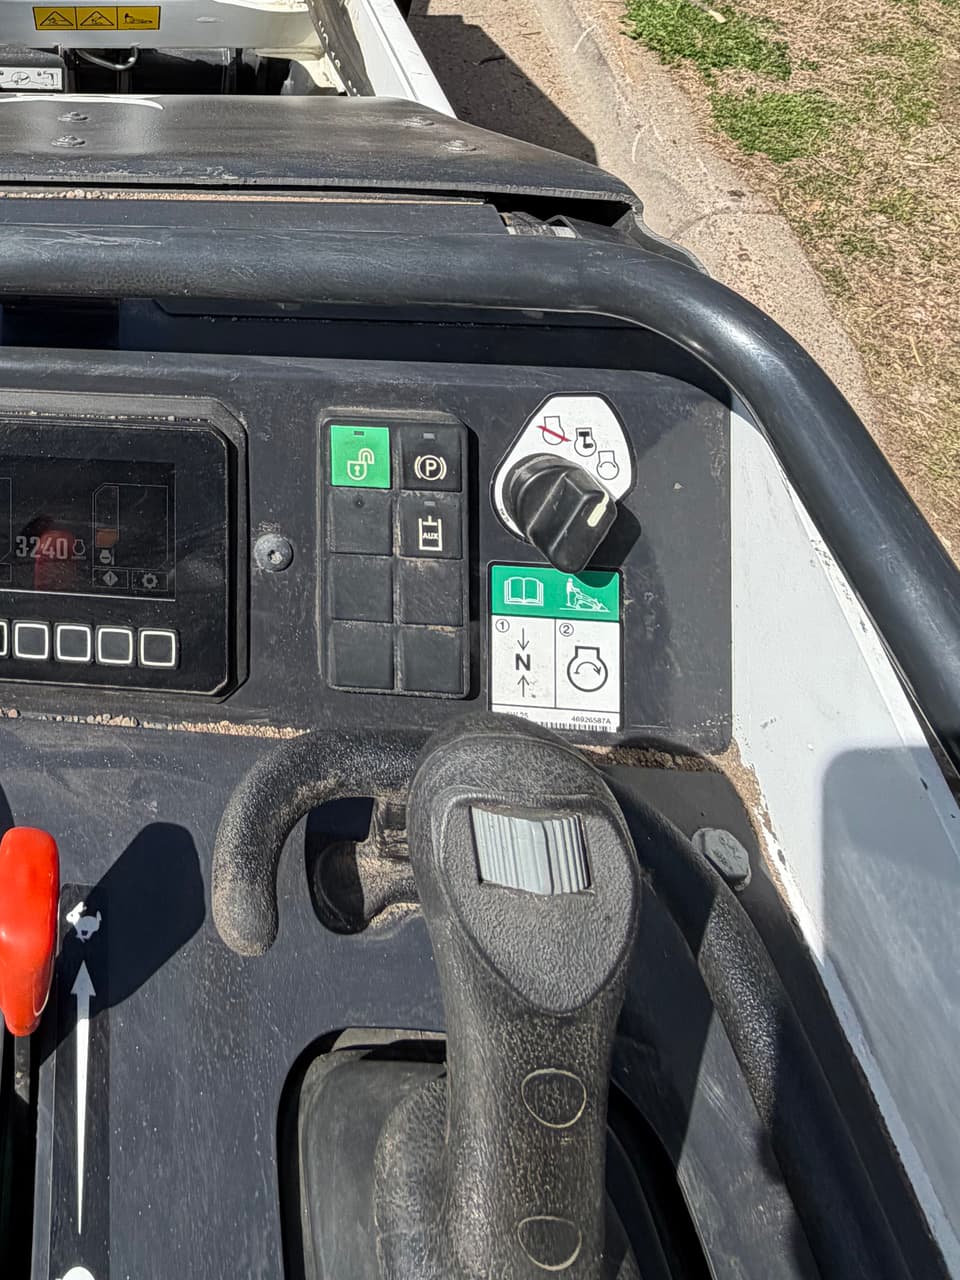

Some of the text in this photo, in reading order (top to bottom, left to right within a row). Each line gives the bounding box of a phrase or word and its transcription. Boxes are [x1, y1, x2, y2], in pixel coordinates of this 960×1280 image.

[422, 532, 439, 540] AUX
[15, 535, 69, 560] 3240
[516, 653, 531, 671] N
